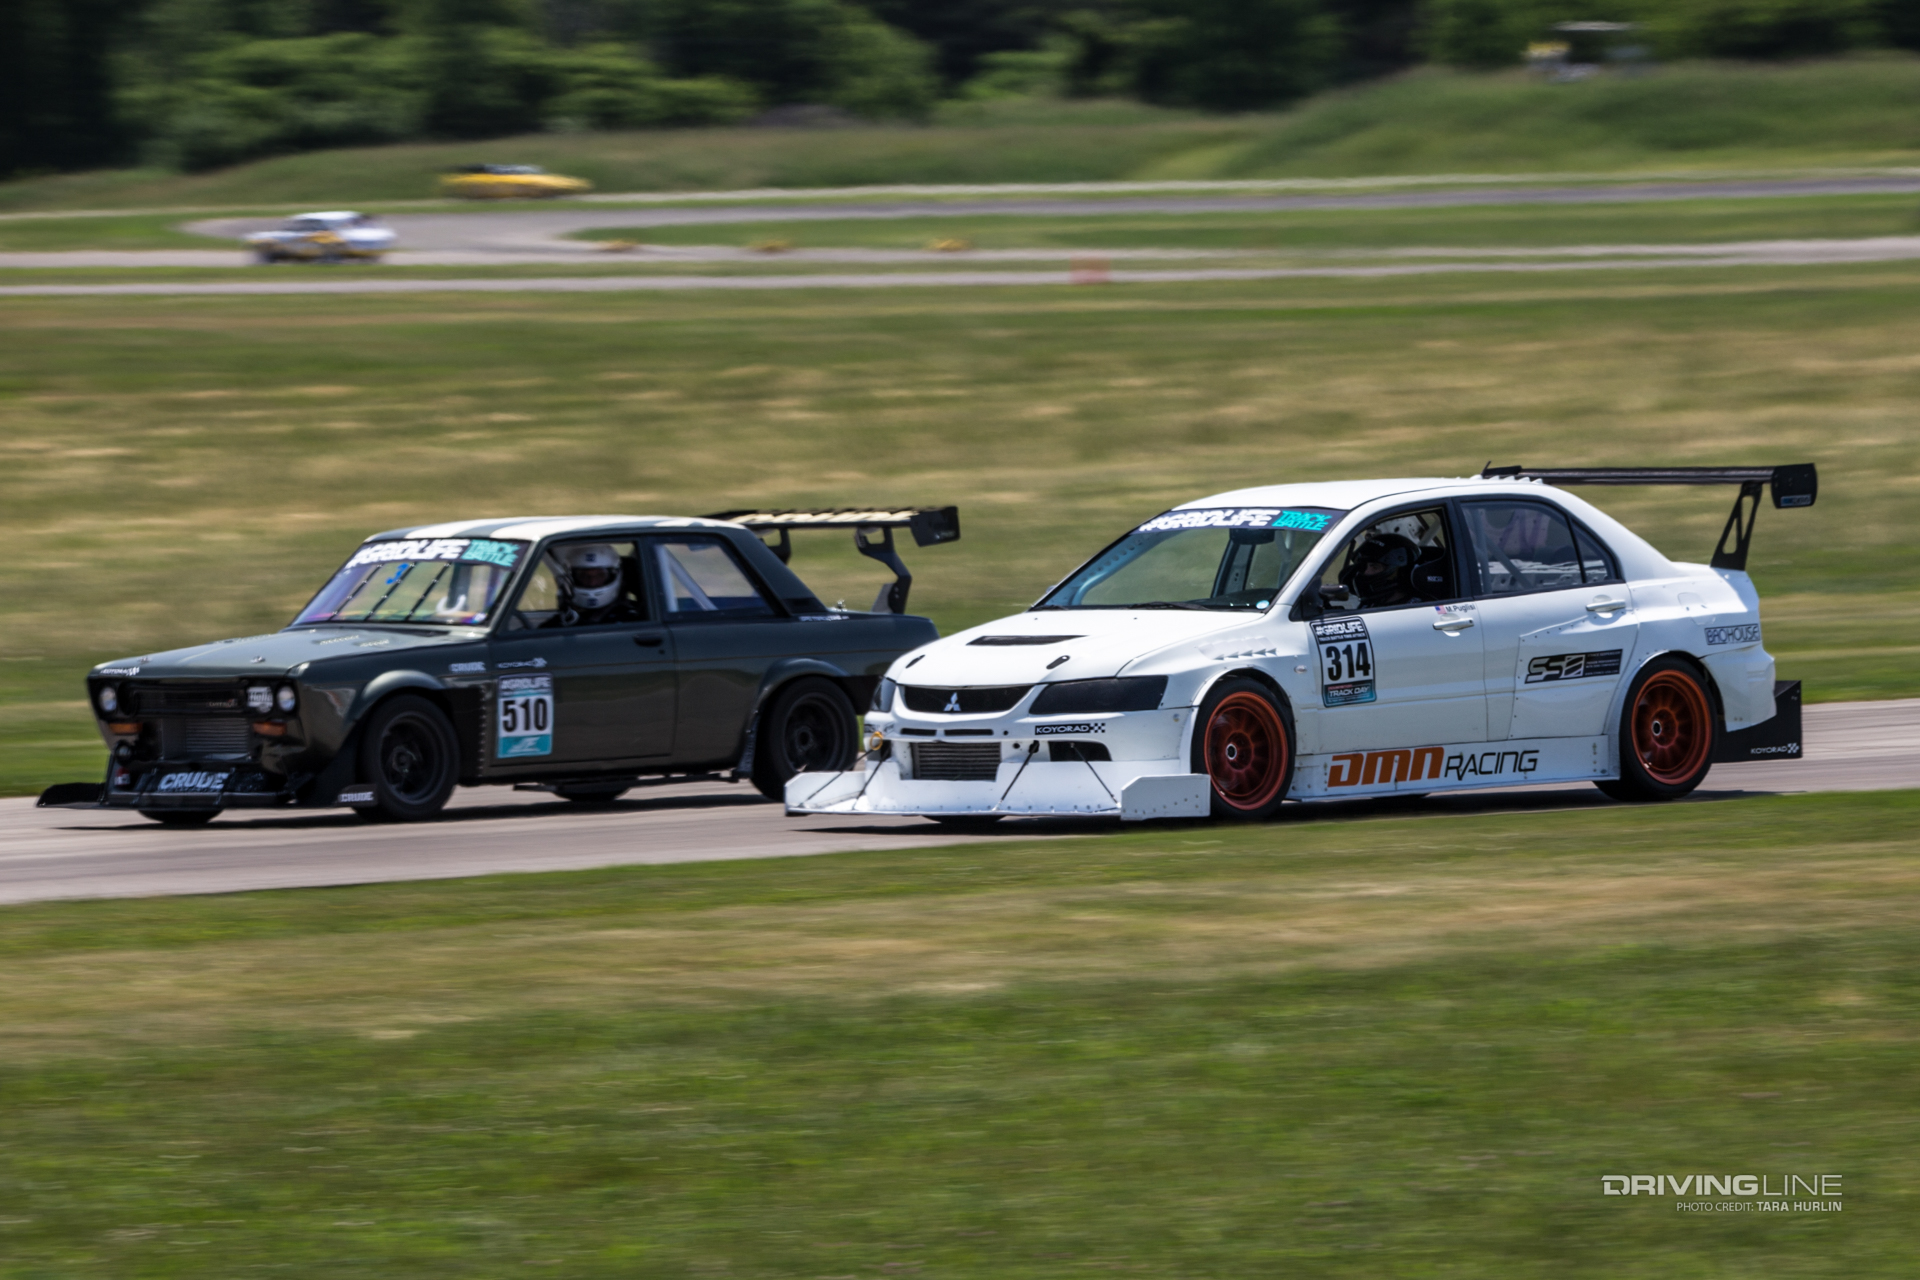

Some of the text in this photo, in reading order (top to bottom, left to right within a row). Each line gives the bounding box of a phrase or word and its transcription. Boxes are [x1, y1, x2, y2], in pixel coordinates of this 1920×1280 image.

[1139, 508, 1281, 532] #GRIDLIFE
[1279, 510, 1332, 522] TRACK
[1272, 520, 1329, 531] BATTLE
[1316, 621, 1364, 636] #GRIDLIFE
[1325, 642, 1371, 681] 314
[1329, 688, 1354, 697] TRACK
[1354, 686, 1370, 694] DAY
[503, 698, 548, 732] 510
[1036, 725, 1089, 735] KOYORAD
[1750, 745, 1788, 754] KOYORAD
[1327, 747, 1540, 787] DMN RACING
[158, 771, 229, 789] CRUDE
[339, 791, 374, 802] CRUDE
